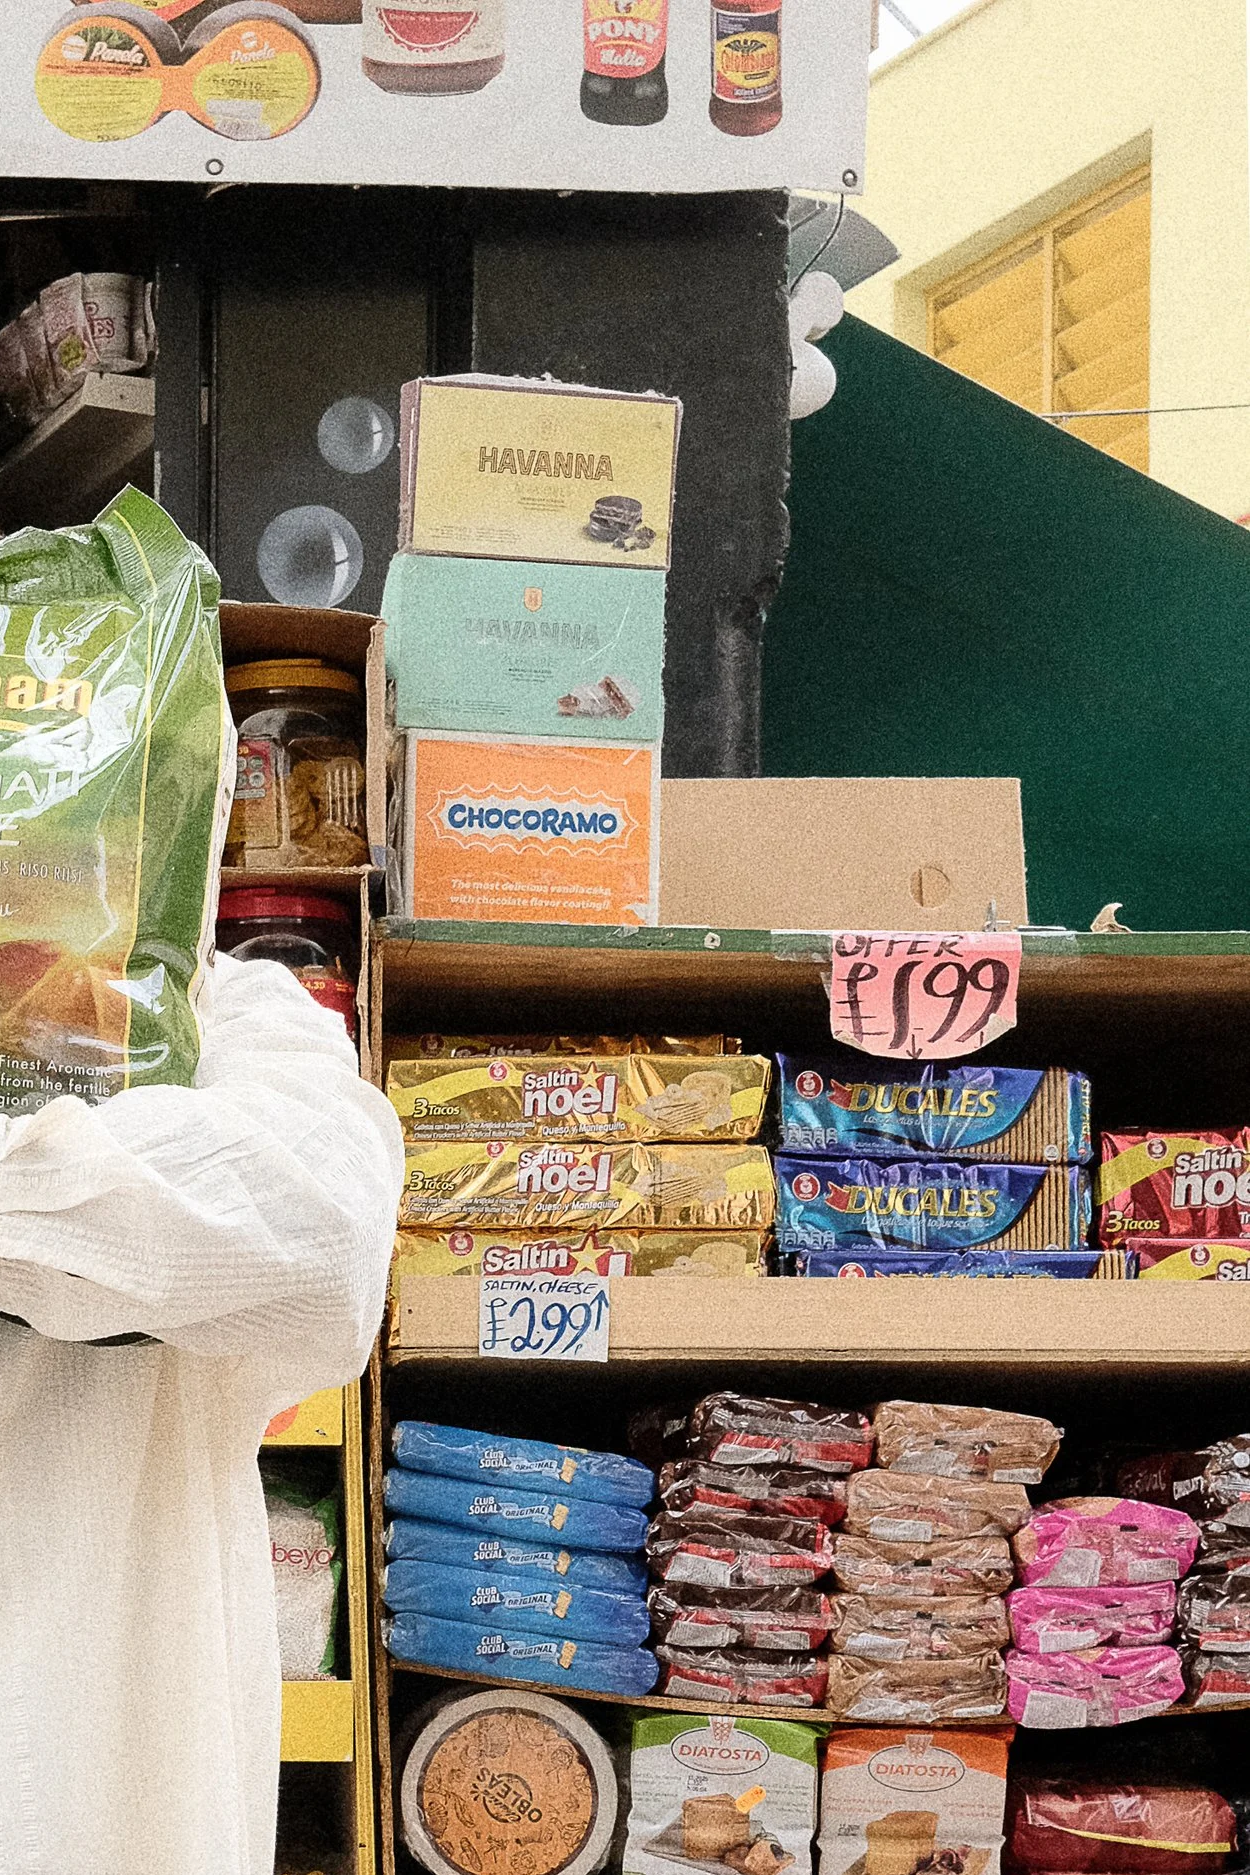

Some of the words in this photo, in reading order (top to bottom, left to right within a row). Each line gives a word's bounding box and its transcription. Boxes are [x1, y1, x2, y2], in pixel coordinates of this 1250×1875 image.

[587, 20, 662, 42] PONY
[478, 446, 614, 481] HAVANNA
[447, 803, 618, 837] CHOCORAMO
[20, 862, 48, 878] RISO
[451, 879, 471, 889] The
[472, 882, 500, 891] most
[501, 882, 549, 893] delicious
[450, 896, 475, 904] with
[477, 896, 528, 905] chocolate
[530, 898, 560, 907] flavor
[835, 934, 964, 958] OFFER
[47, 1060, 112, 1078] Aromatic
[1, 1072, 33, 1088] from
[40, 1078, 62, 1091] the
[68, 1078, 110, 1096] fertile
[524, 1070, 578, 1090] Saltín
[35, 1095, 51, 1107] of
[523, 1074, 616, 1117] noel
[849, 1084, 998, 1117] DUCALES
[542, 1125, 571, 1136] Queso
[579, 1123, 626, 1133] Mantequilla
[1176, 1149, 1242, 1174] Saltín
[518, 1154, 612, 1193] noel
[1106, 1211, 1123, 1232] 3
[1123, 1218, 1160, 1230] Tacos
[484, 1243, 569, 1272] Saltín
[539, 1280, 598, 1294] CHEESE
[480, 1458, 509, 1469] SOCIAL
[484, 1451, 504, 1459] CLUB
[516, 1461, 554, 1470] ORIGINAL
[470, 1504, 498, 1514] SOCIAL
[474, 1497, 495, 1507] CLUB
[505, 1508, 545, 1517] ORIGINAL
[272, 1542, 332, 1570] beyo
[678, 1744, 763, 1762] DIATOSTA
[875, 1763, 959, 1778] DIATOSTA
[476, 1768, 542, 1822] OBLEAS
